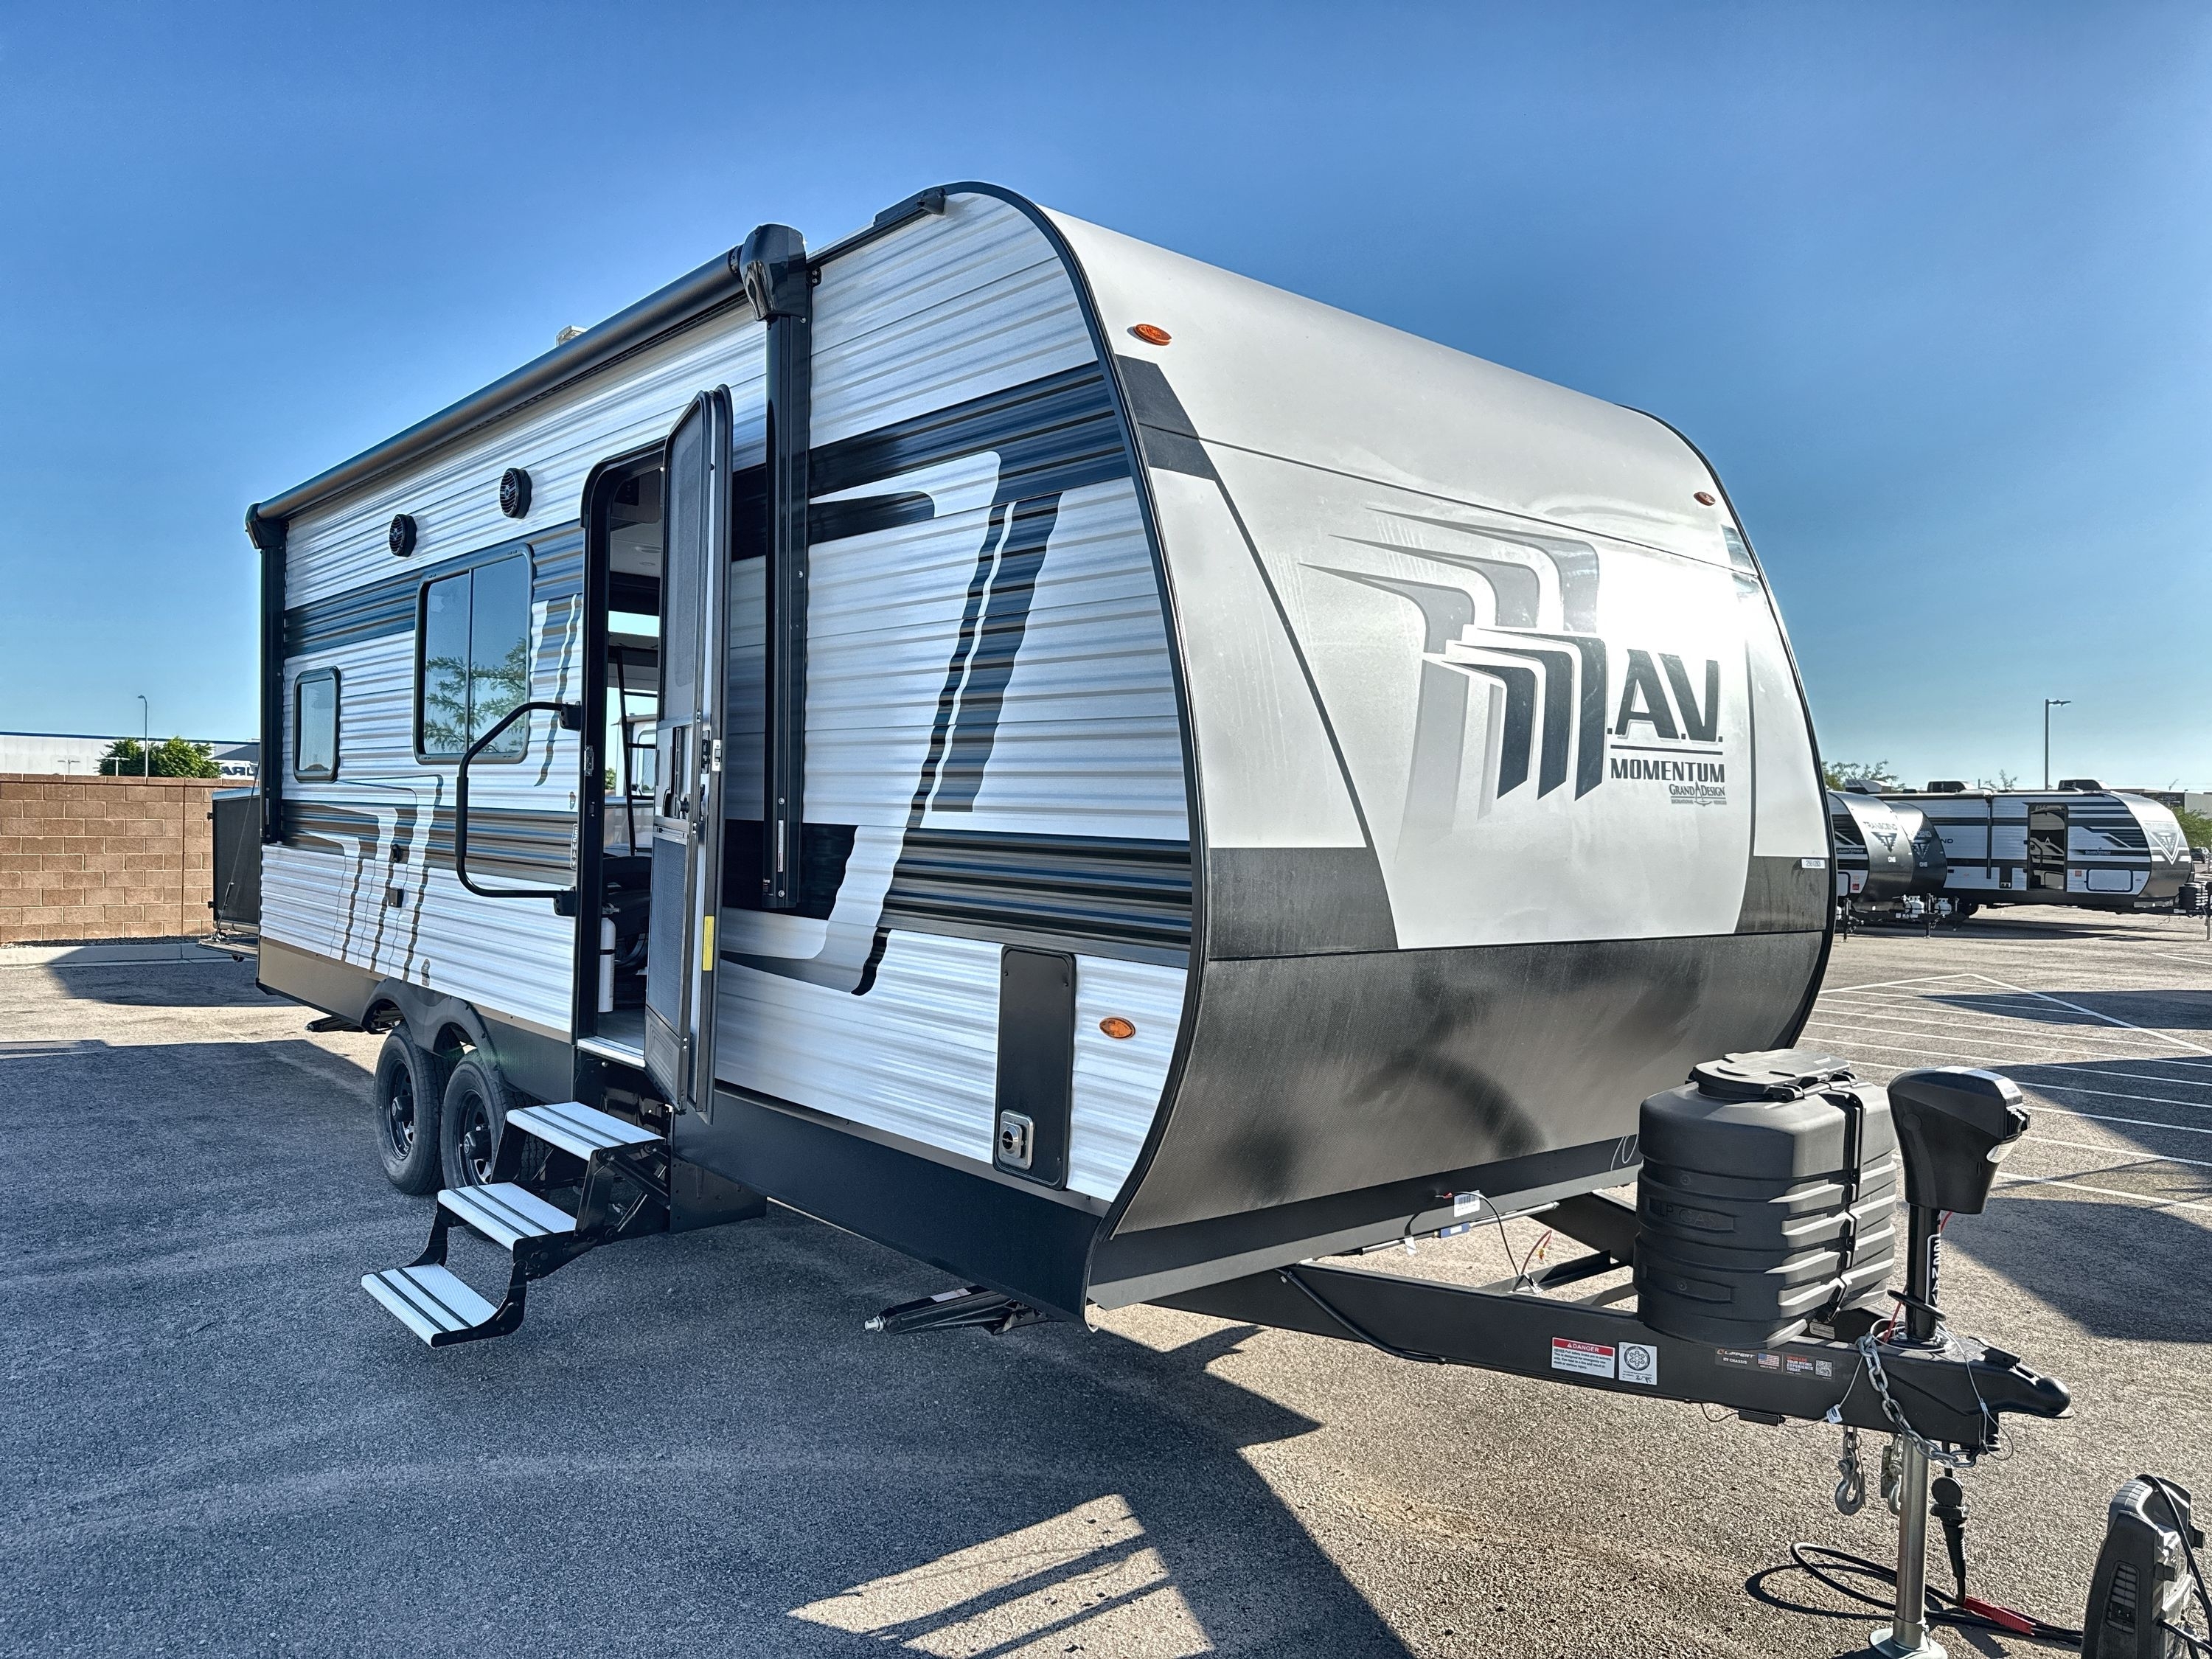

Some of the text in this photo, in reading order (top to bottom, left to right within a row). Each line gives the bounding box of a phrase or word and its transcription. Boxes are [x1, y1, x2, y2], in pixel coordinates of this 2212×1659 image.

[1610, 758, 1725, 782] MOMENTUM
[1669, 784, 1725, 796] GRAND DESIGN
[1572, 1343, 1599, 1353] DANGER
[1724, 1350, 1756, 1358] LIPPERT
[1787, 1363, 1814, 1371] EXPERIENCE
